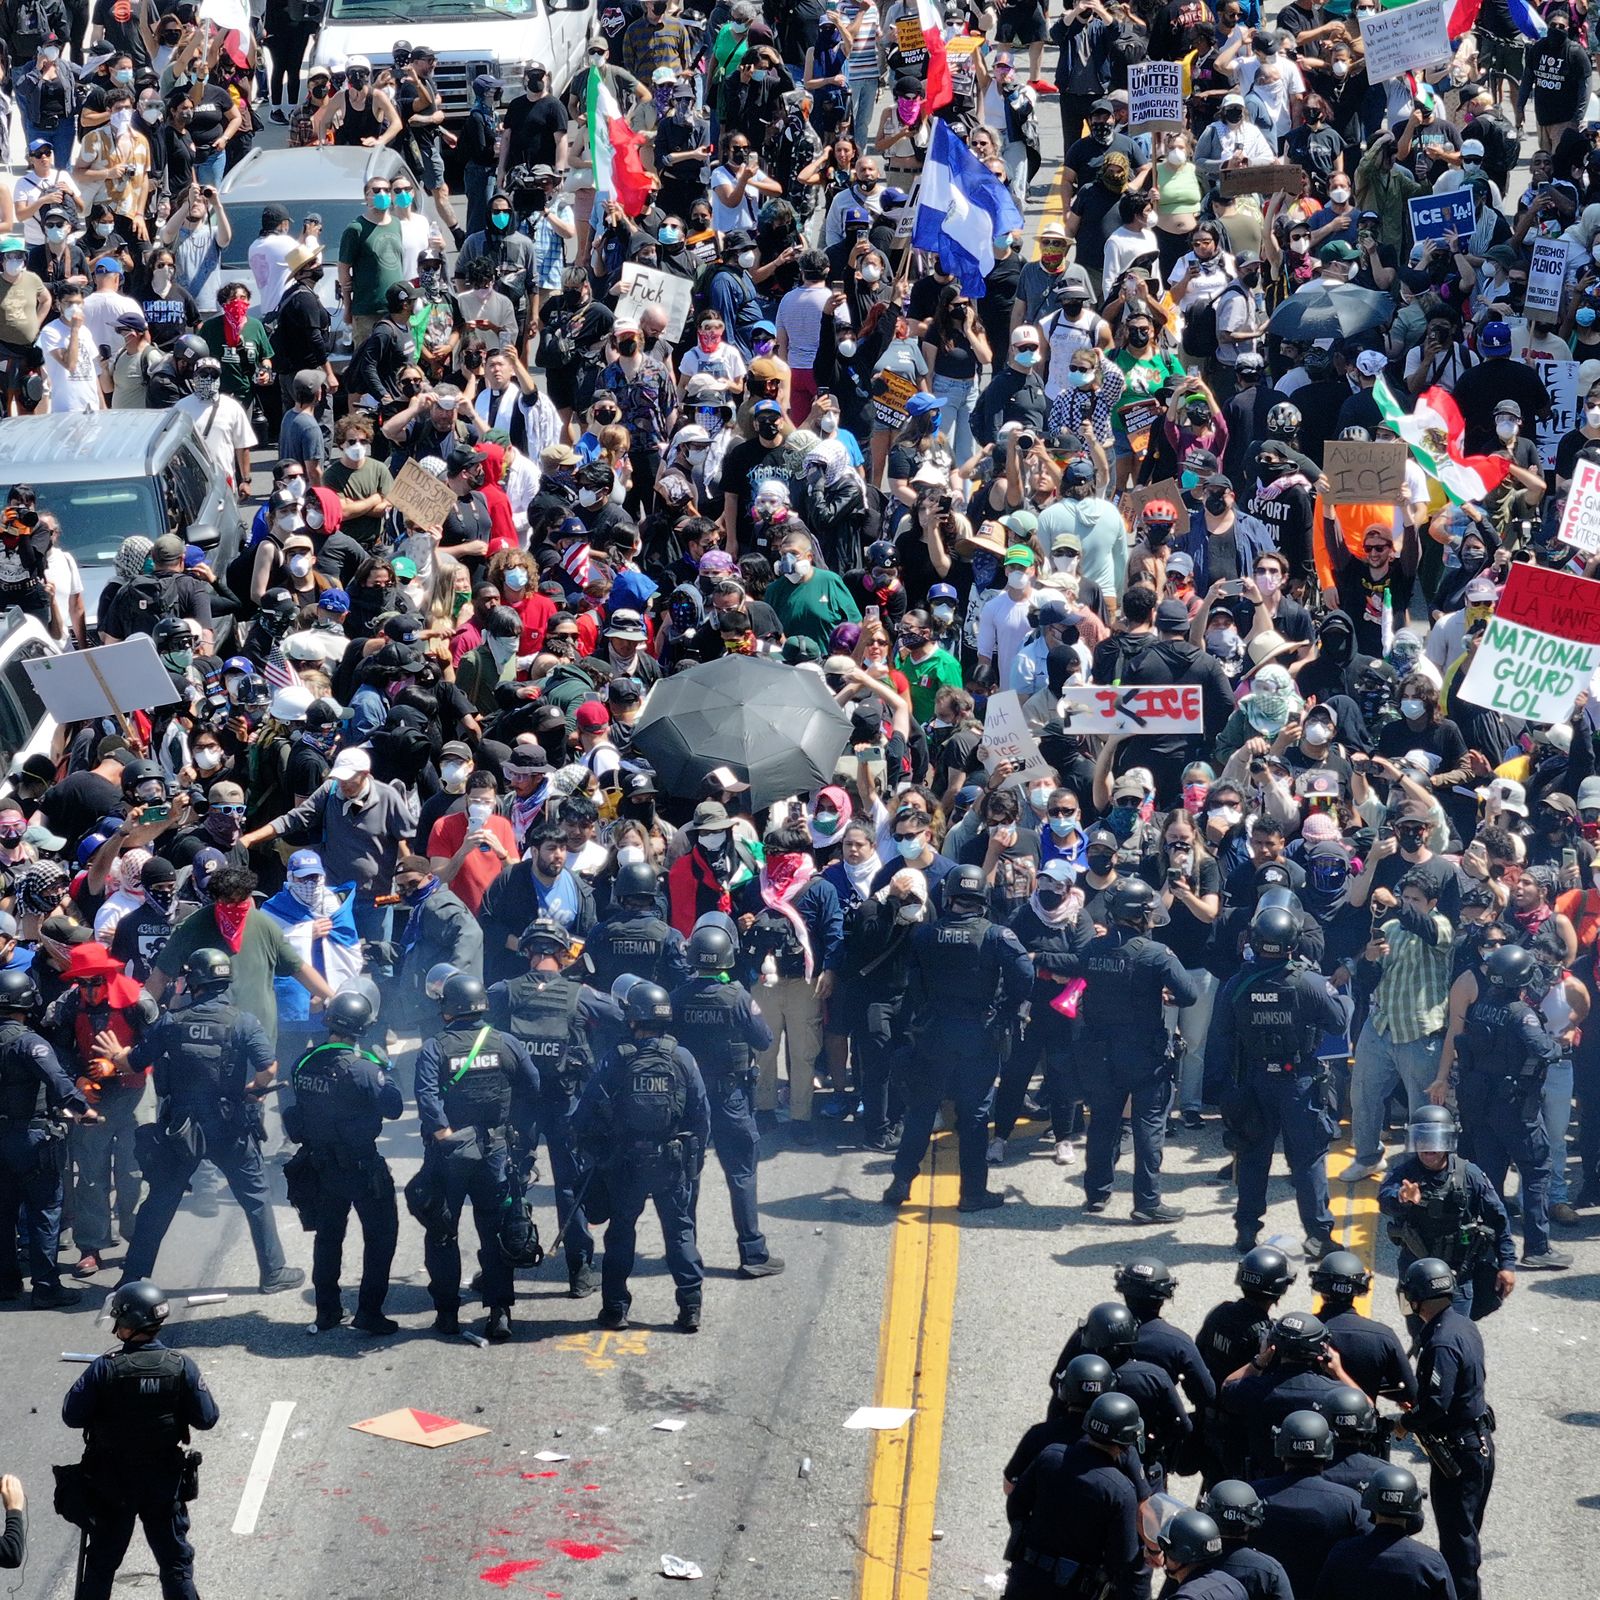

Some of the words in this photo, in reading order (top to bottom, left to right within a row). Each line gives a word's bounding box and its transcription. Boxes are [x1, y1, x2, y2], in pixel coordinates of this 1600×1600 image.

[1147, 64, 1178, 74] PEOPLE
[1131, 74, 1178, 89] UNITED
[1131, 89, 1148, 98] WILL
[1149, 86, 1178, 95] DEFEND
[1131, 99, 1177, 111] IMMIGRANT
[1132, 108, 1179, 122] FAMILIES!
[1413, 207, 1443, 227] ICE
[1452, 201, 1472, 220] LA!
[1533, 245, 1565, 259] DERECHOS
[1531, 257, 1563, 276] PLENOS
[630, 273, 665, 304] Fuck
[1334, 466, 1399, 496] ICE
[1512, 590, 1539, 620] LA
[1484, 620, 1592, 672] NATIONAL
[1493, 658, 1574, 697] GUARD
[1491, 683, 1541, 718] LOL
[994, 744, 1022, 757] ICE
[936, 929, 971, 944] URIBE
[612, 940, 656, 955] FREEMAN
[1251, 993, 1278, 1002] POLICE
[684, 1010, 725, 1025] CORONA
[1251, 1011, 1292, 1025] JOHNSON
[191, 1026, 213, 1040] GIL
[633, 1076, 669, 1092] LEONE
[140, 1378, 160, 1393] KIM
